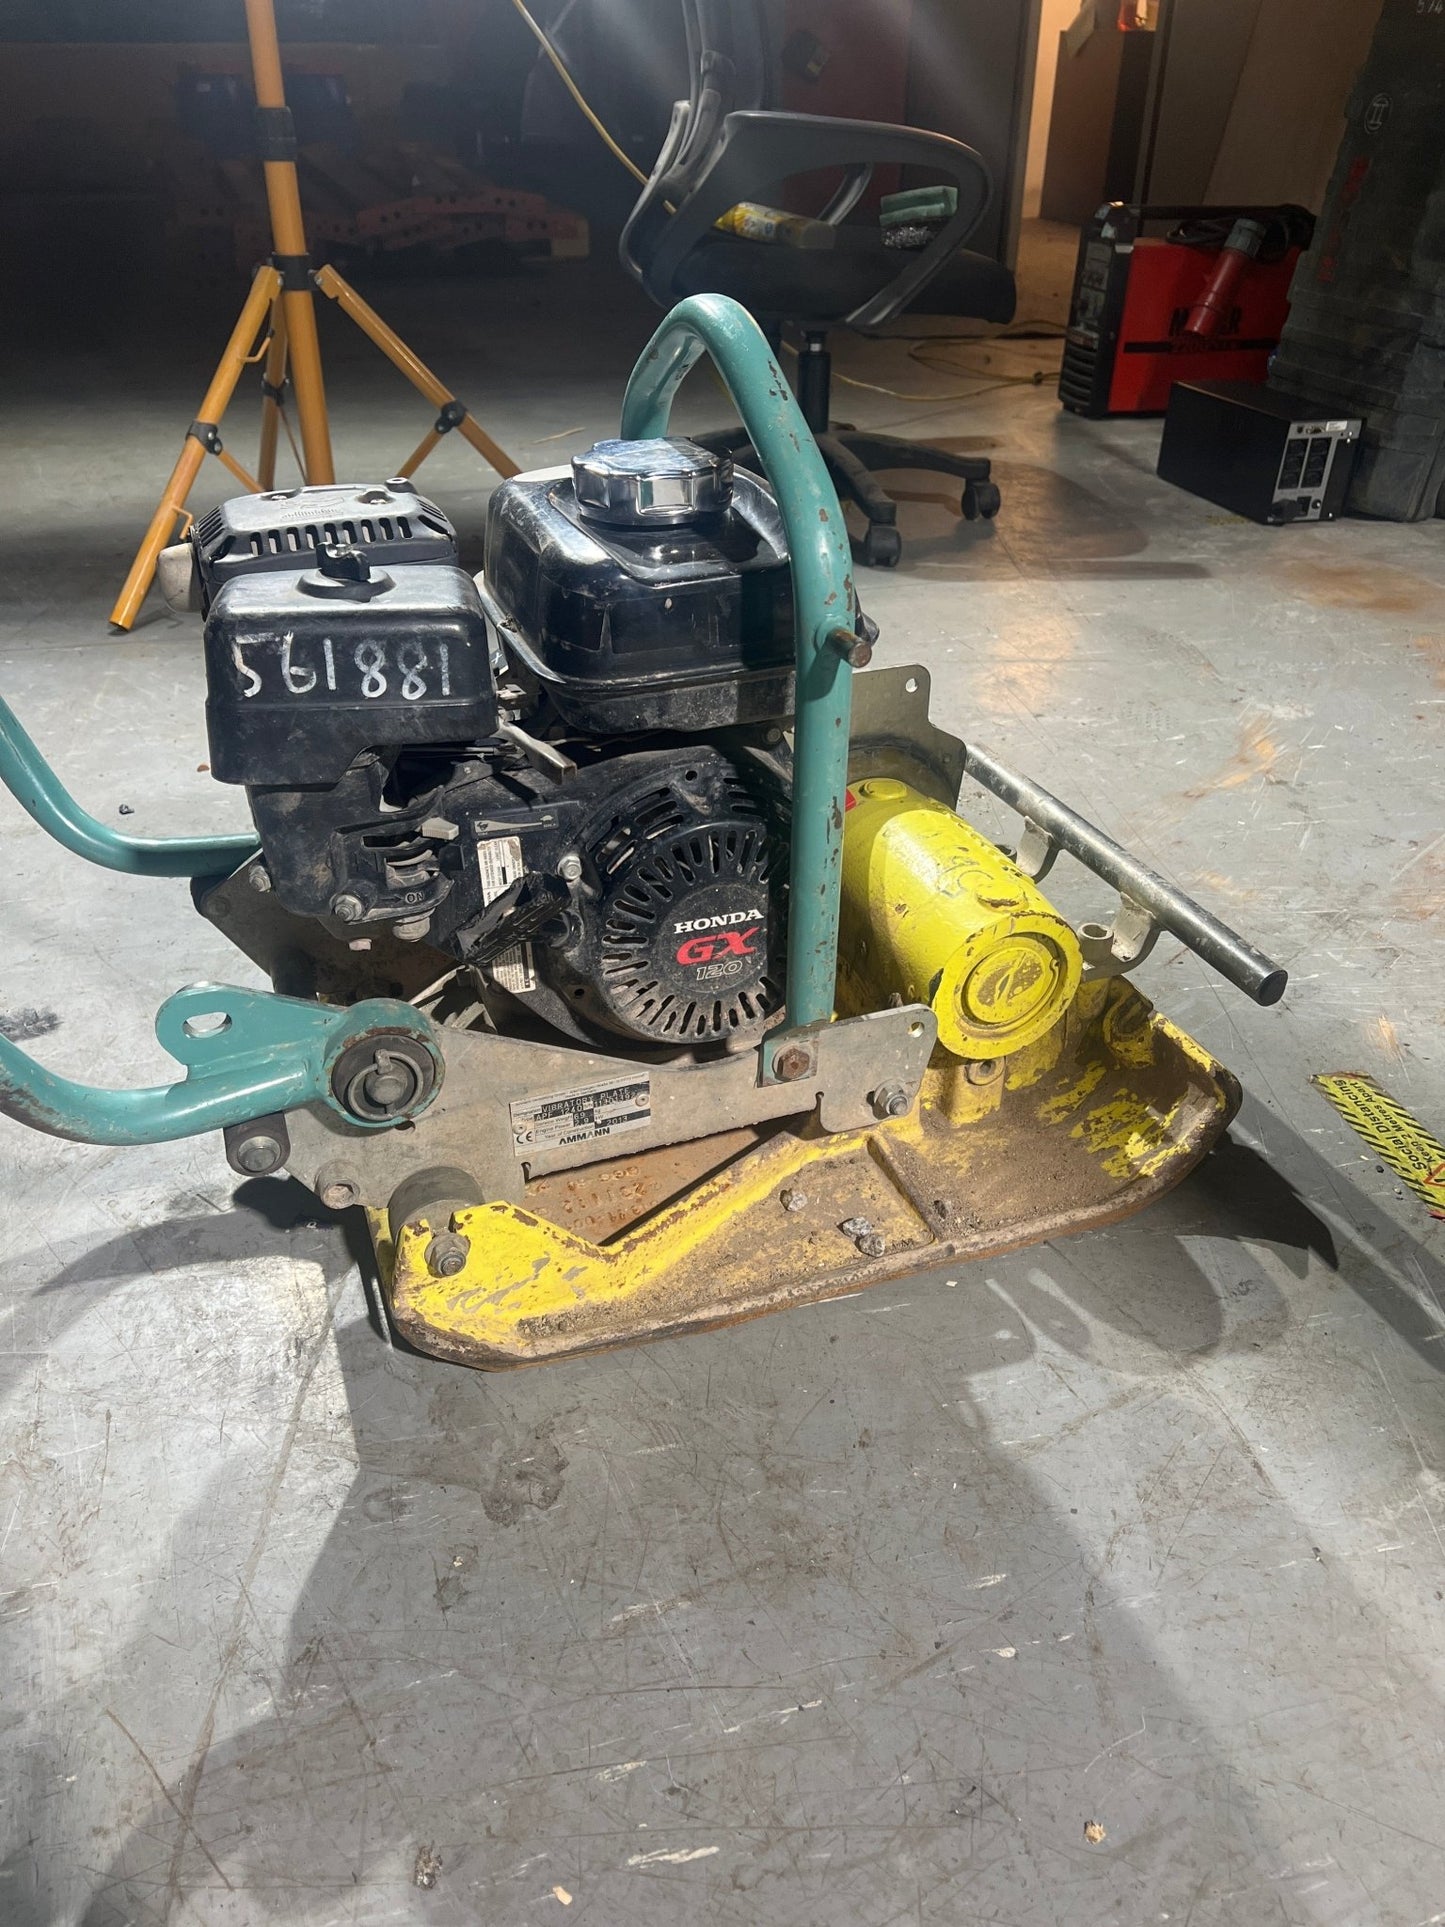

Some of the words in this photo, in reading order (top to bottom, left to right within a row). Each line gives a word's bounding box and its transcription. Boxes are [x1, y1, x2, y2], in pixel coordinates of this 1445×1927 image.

[232, 630, 450, 700] 561881
[405, 891, 425, 904] ON
[674, 908, 764, 934] HONDA
[676, 926, 760, 966] GX
[696, 960, 743, 980] 120
[542, 1094, 593, 1112] VIBRATORY
[600, 1087, 630, 1099] PLATE
[1349, 1082, 1376, 1103] Apart
[561, 1103, 583, 1115] 1240
[574, 1111, 586, 1121] 69
[1333, 1079, 1392, 1134] Distancing
[607, 1115, 628, 1126] 2013
[1374, 1104, 1404, 1132] Metres
[559, 1126, 611, 1146] AMMANN
[1385, 1135, 1428, 1171] Social
[1410, 1141, 1436, 1163] Keep
